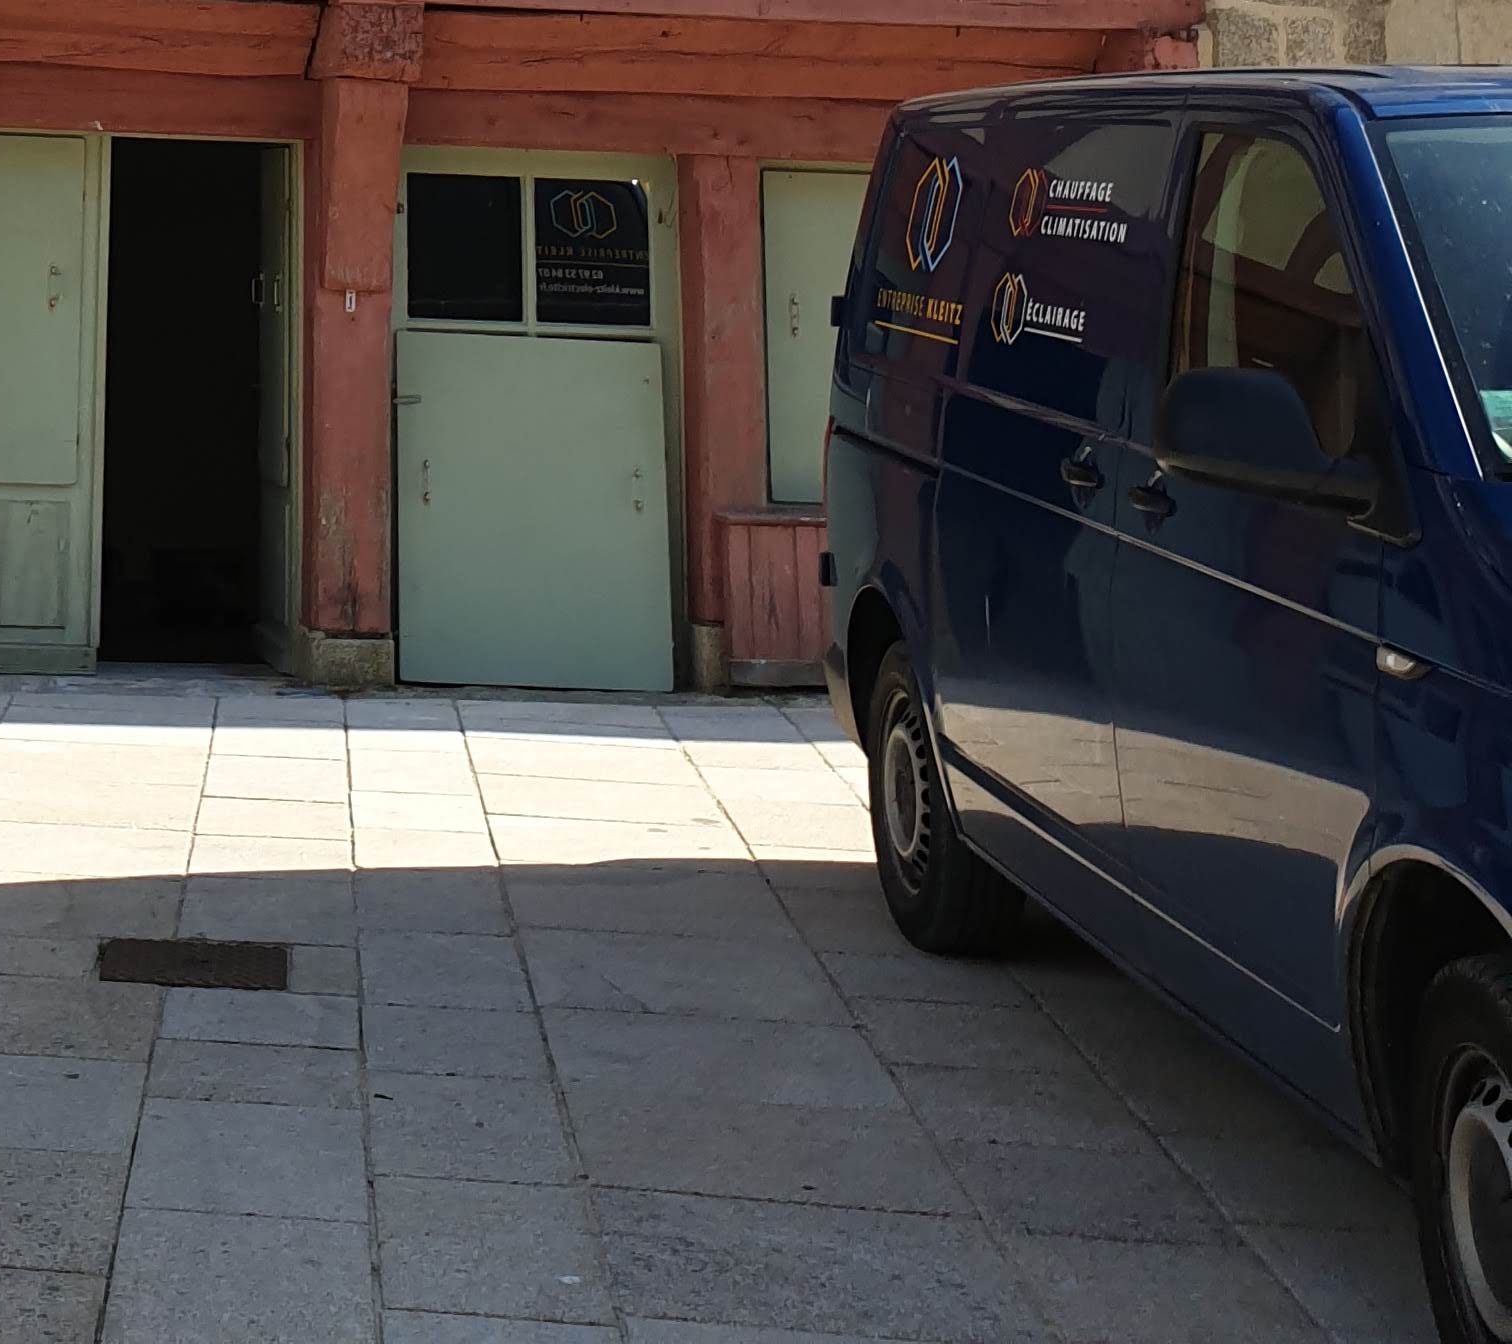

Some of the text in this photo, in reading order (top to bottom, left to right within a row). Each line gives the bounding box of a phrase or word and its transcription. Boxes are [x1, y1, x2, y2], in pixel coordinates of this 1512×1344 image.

[1049, 179, 1115, 202] CHAUFFAGE
[1040, 215, 1128, 244] CLIMATISATION
[876, 287, 963, 325] ENTREPRISE KLEITZ
[1026, 297, 1086, 332] ÉCLAIRAGE
